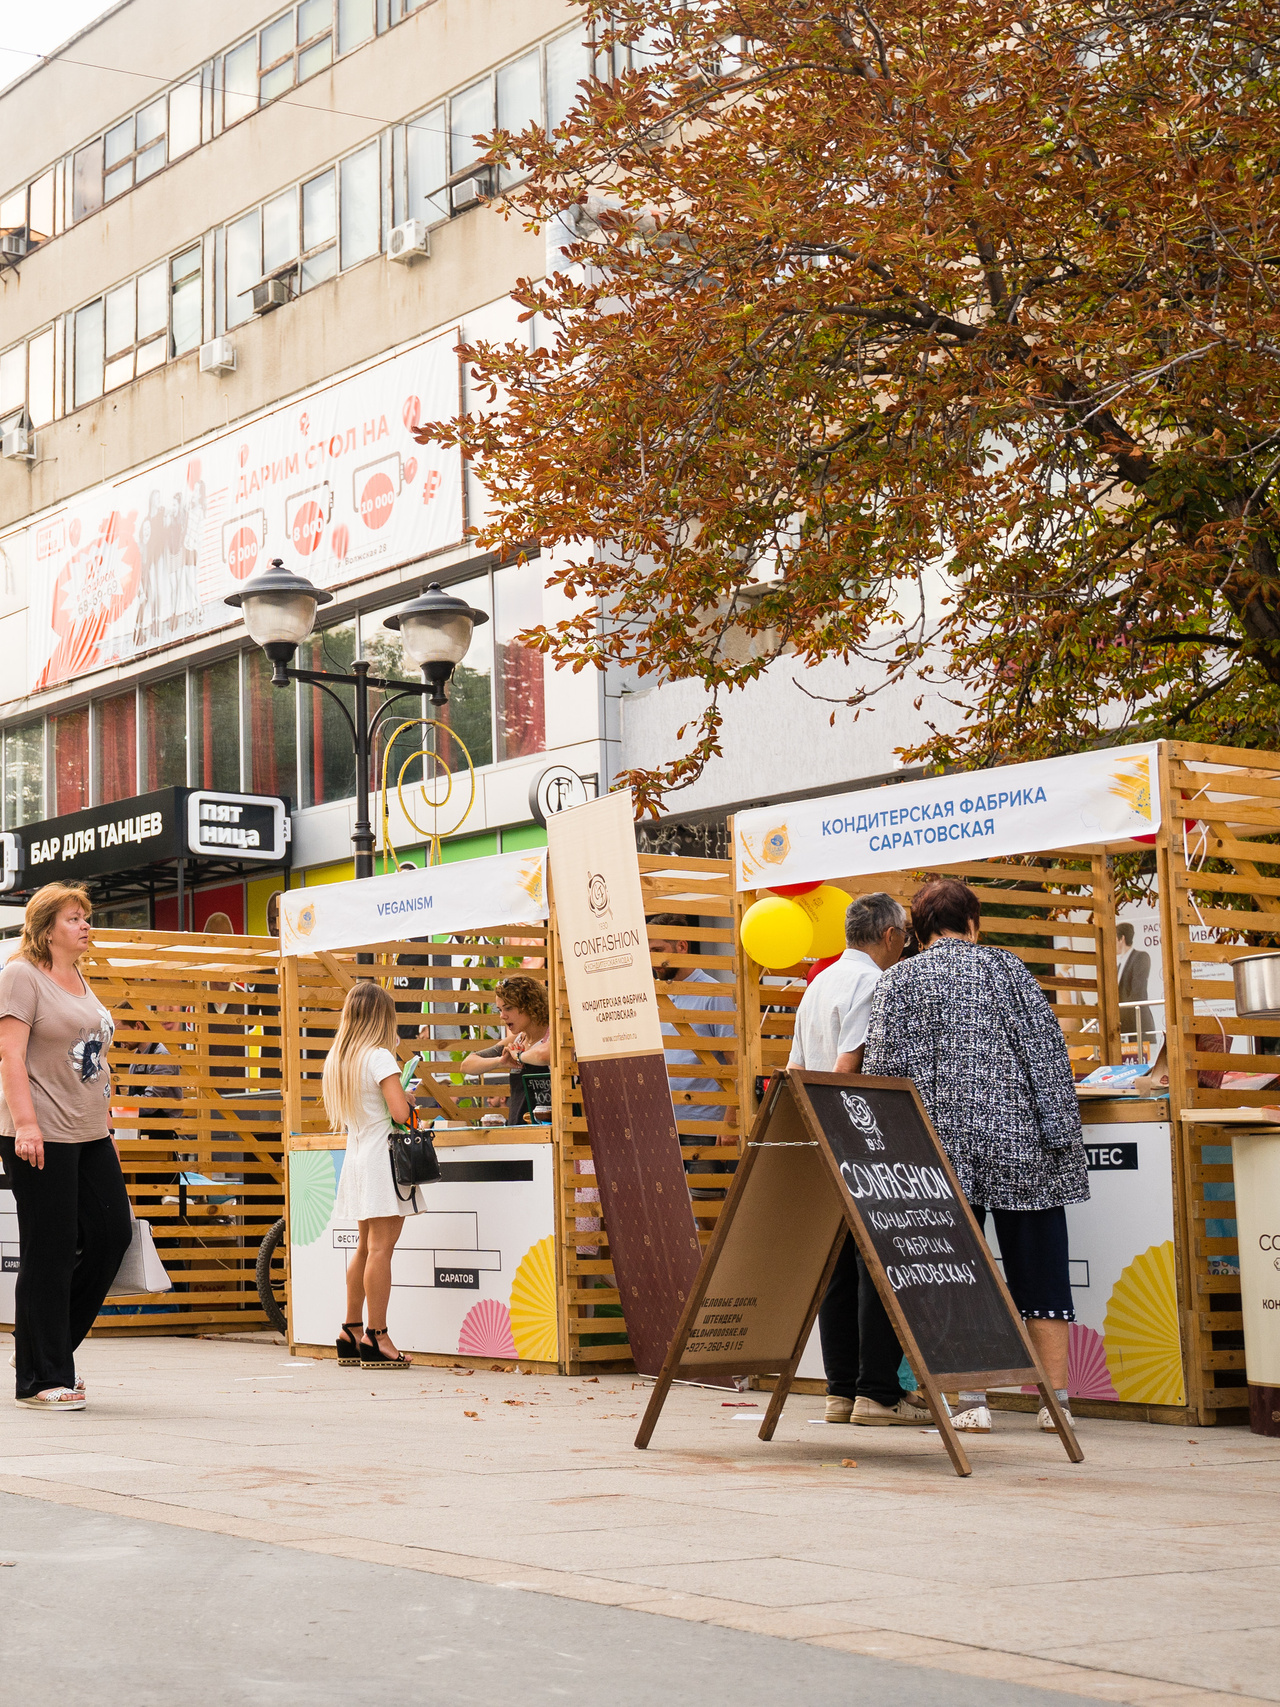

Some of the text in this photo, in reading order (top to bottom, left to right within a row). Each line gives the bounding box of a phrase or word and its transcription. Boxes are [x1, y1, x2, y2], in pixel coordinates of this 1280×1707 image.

[236, 414, 390, 504] ДАРИМ СТОЛ НА
[361, 491, 395, 515] 10 000
[294, 517, 324, 542] 8 000
[228, 542, 258, 565] 6 000
[822, 786, 1047, 836] КОНДИТЕРСКАЯ ФАБРИКА
[31, 811, 163, 865] БАР ДЛЯ ТАНЦЕВ
[869, 818, 995, 852] САРАТОВСКАЯ
[377, 895, 433, 917] VEGANISM
[574, 929, 640, 957] CONFASHION
[582, 993, 648, 1012] КОНДИТЕРСКАЯ ФАБРИКА
[596, 1009, 637, 1022] «САРАТОВСКАЯ»
[840, 1161, 954, 1200] CONFASHION
[869, 1208, 956, 1230] КОНДИТЕРСКАЯ
[337, 1234, 360, 1244] ФЕСТИ
[893, 1236, 955, 1257] ФАБРИКА
[4, 1260, 20, 1270] САРАТ
[439, 1273, 474, 1284] САРАТОВ
[703, 1314, 743, 1325] ШТЕНДЕРЫ
[684, 1340, 744, 1352] -927-260-9115
